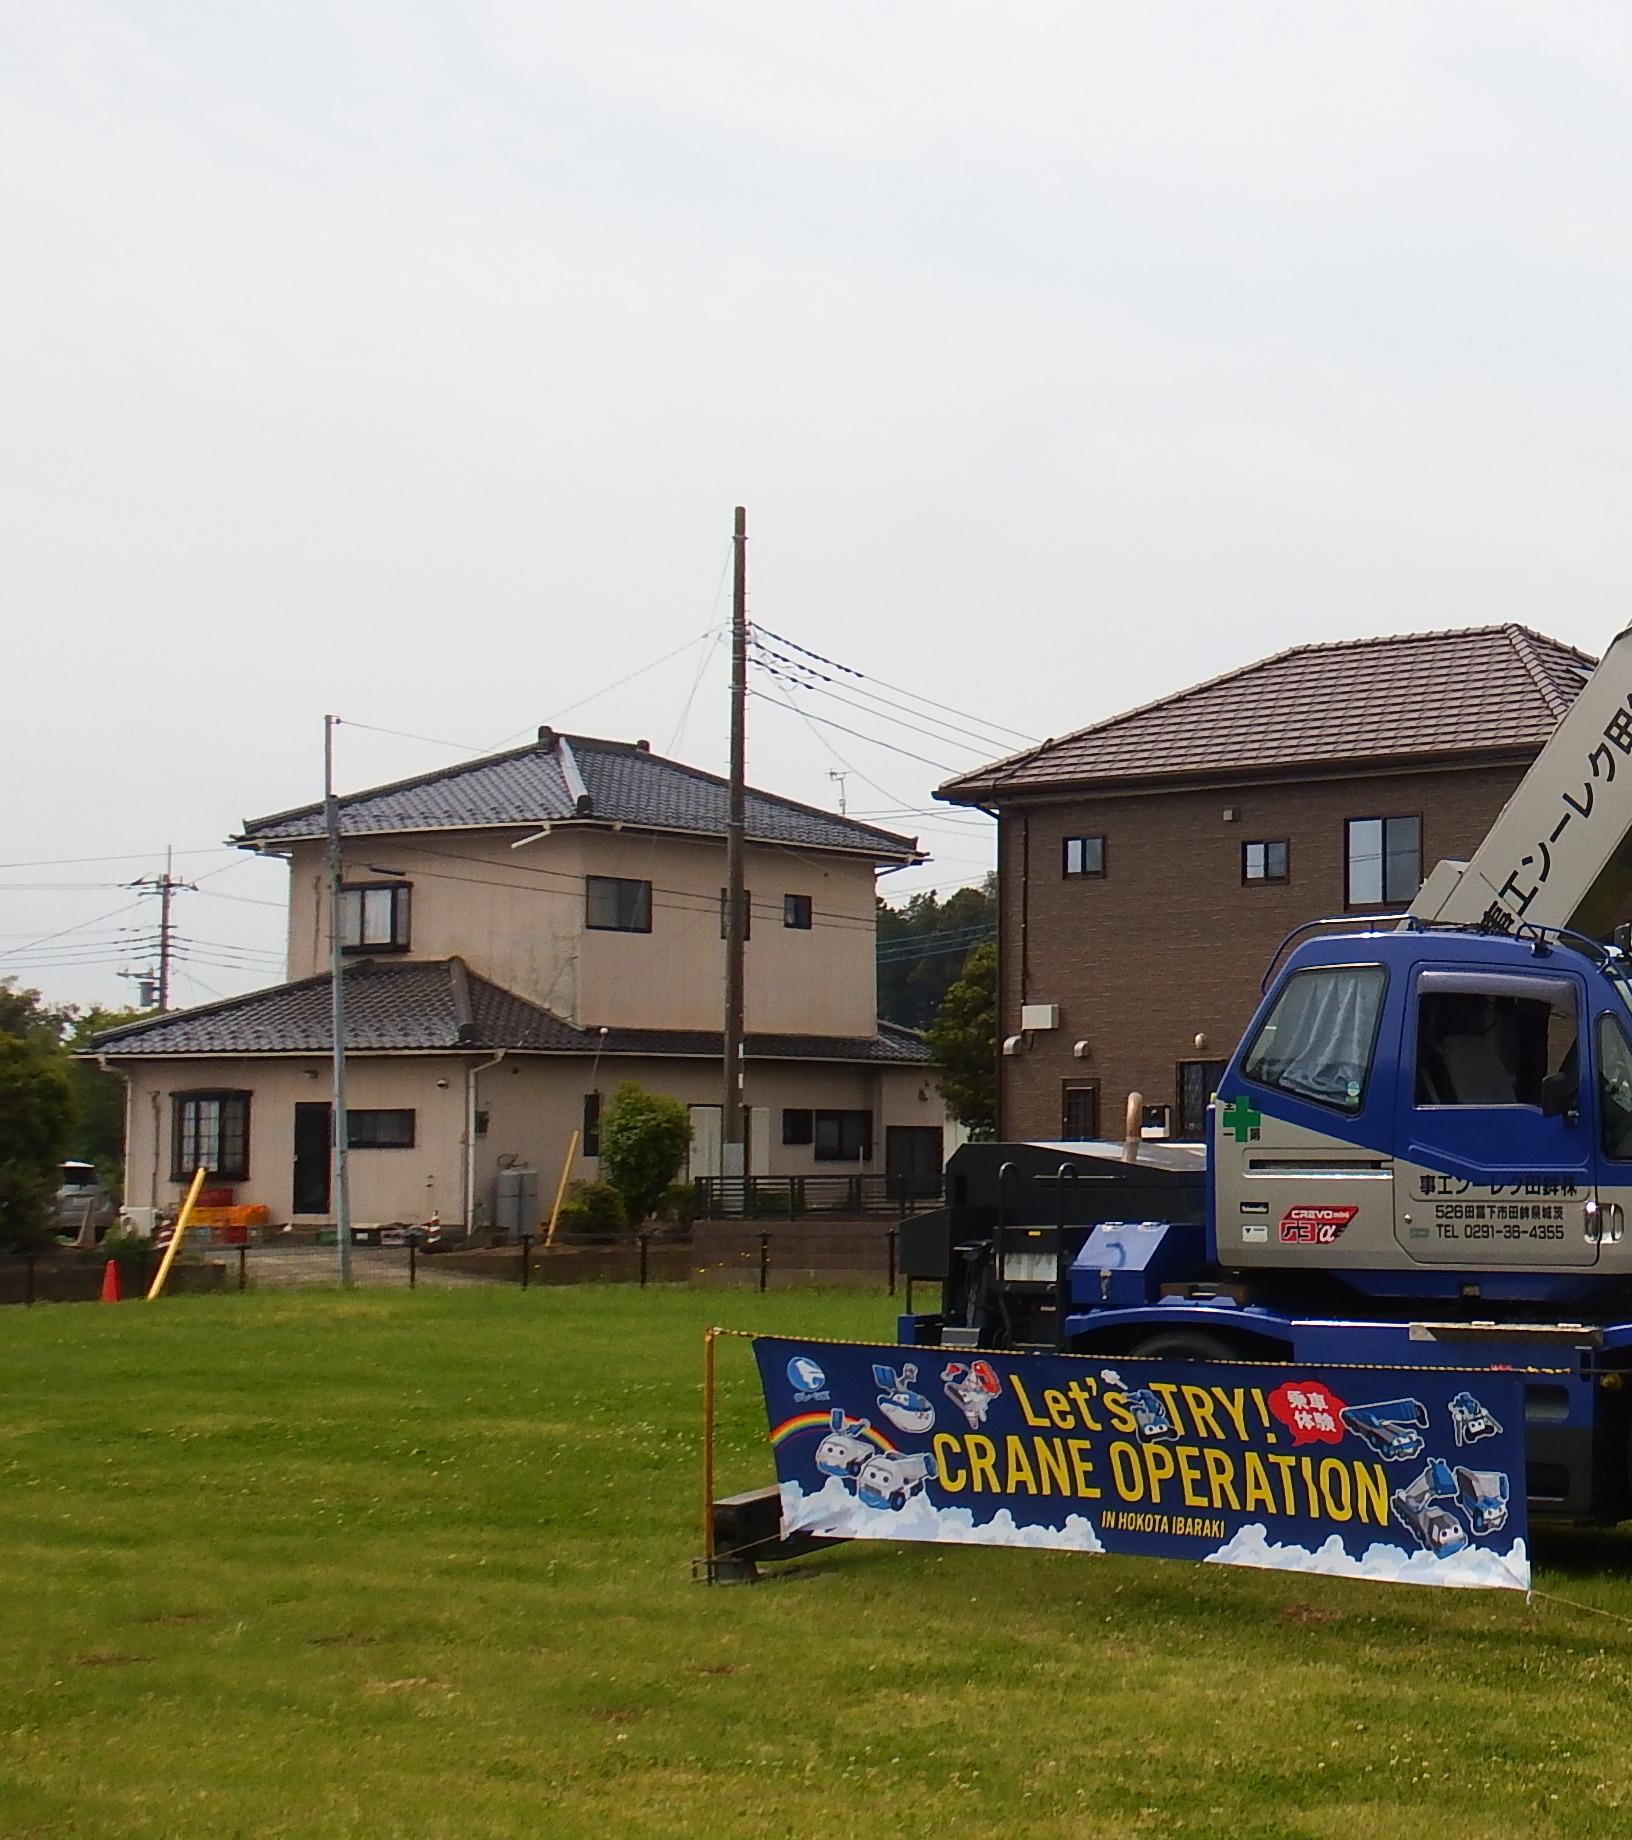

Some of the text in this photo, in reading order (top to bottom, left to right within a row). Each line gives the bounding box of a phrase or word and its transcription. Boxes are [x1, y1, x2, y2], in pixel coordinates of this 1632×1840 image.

[1291, 1209, 1333, 1219] CREVO
[1435, 1223, 1565, 1239] TEL 0291-36-4355
[1009, 1373, 1277, 1445] Let's TRY!
[932, 1432, 1390, 1527] CRANE OPERATION
[1101, 1510, 1226, 1540] IN HOKOTA IBARAKI
